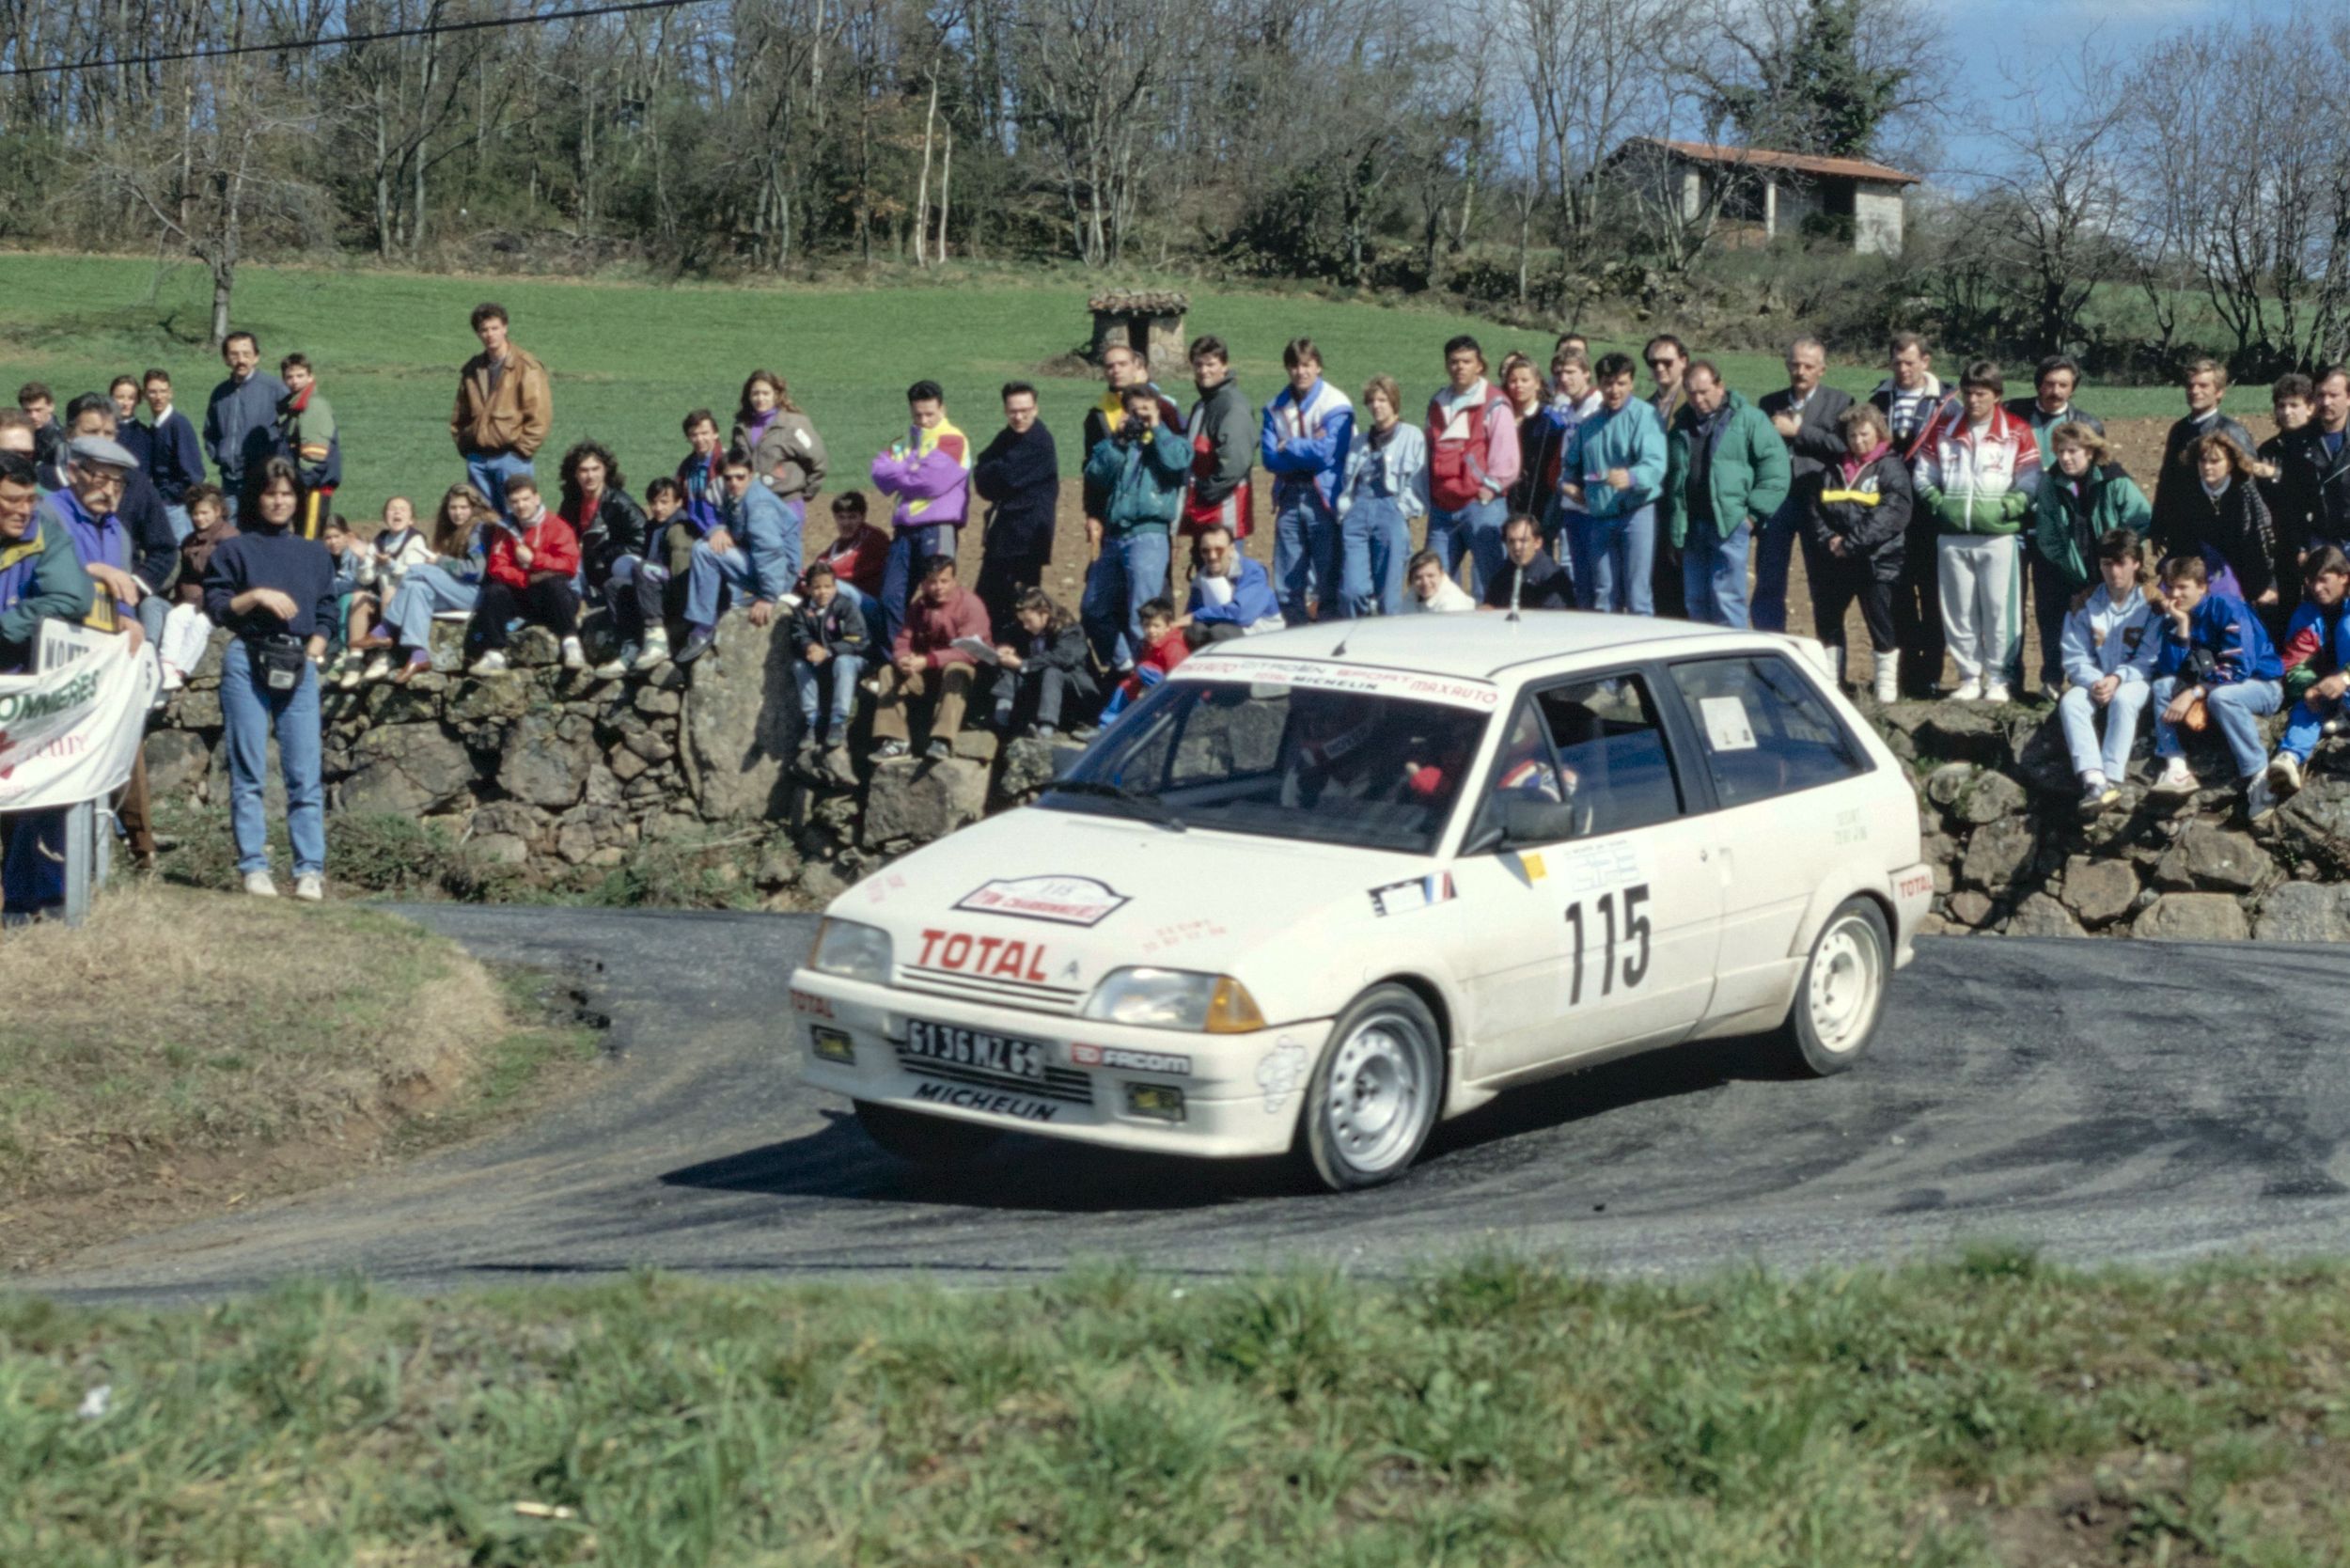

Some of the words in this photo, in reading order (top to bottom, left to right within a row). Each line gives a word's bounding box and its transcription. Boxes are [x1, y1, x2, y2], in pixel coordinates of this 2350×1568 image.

[1292, 675, 1379, 691] MICHELIN
[1410, 680, 1498, 705] MAXAUTO
[1899, 874, 1934, 899] TOTAL
[918, 928, 1047, 983] TOTAL
[1564, 882, 1652, 1008] 115
[914, 1082, 1059, 1121] MICHELIN
